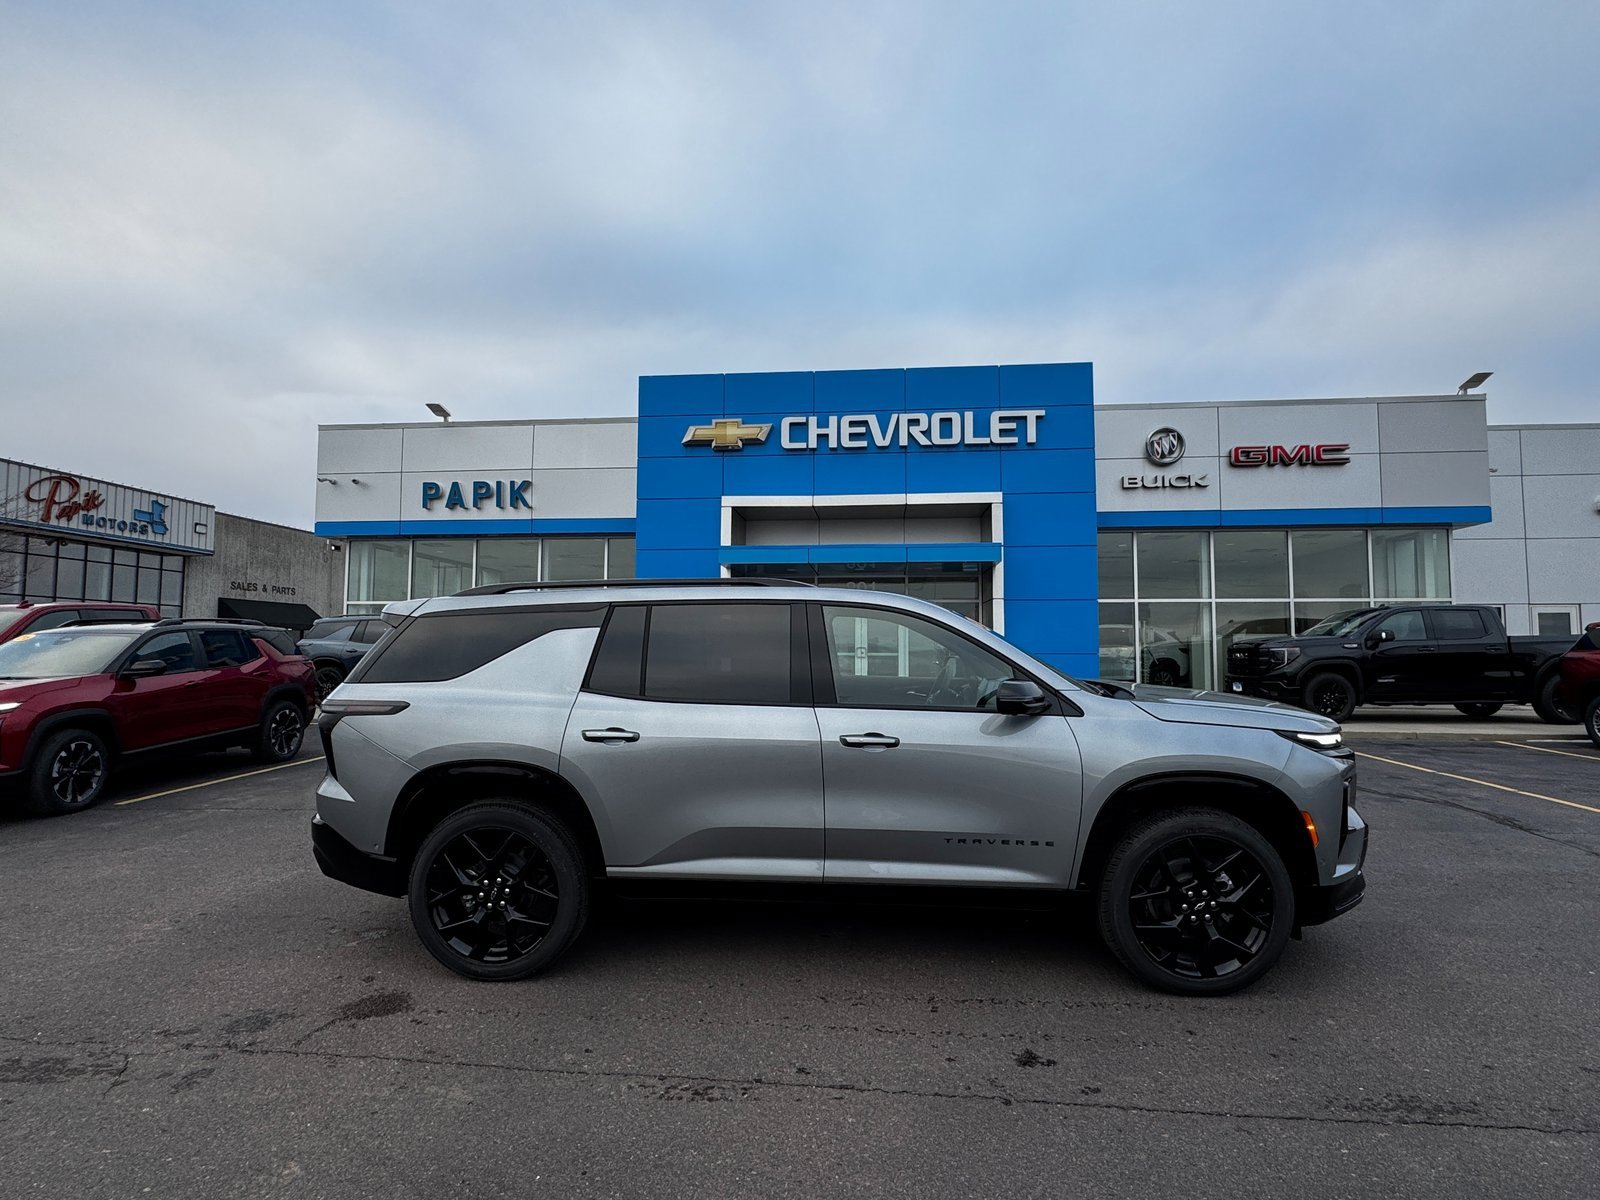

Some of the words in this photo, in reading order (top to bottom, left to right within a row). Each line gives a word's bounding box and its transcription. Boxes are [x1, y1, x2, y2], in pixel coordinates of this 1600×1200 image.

[780, 409, 1045, 450] CHEVROLET
[1229, 443, 1350, 468] GMC
[1122, 473, 1208, 489] BUICK
[26, 475, 105, 523] Papik
[422, 480, 533, 509] PAPIK
[82, 513, 148, 536] MOTORS
[230, 581, 258, 592] SALES
[262, 584, 268, 593] &
[271, 585, 296, 596] PARTS
[944, 838, 1055, 847] TRAVERSE
